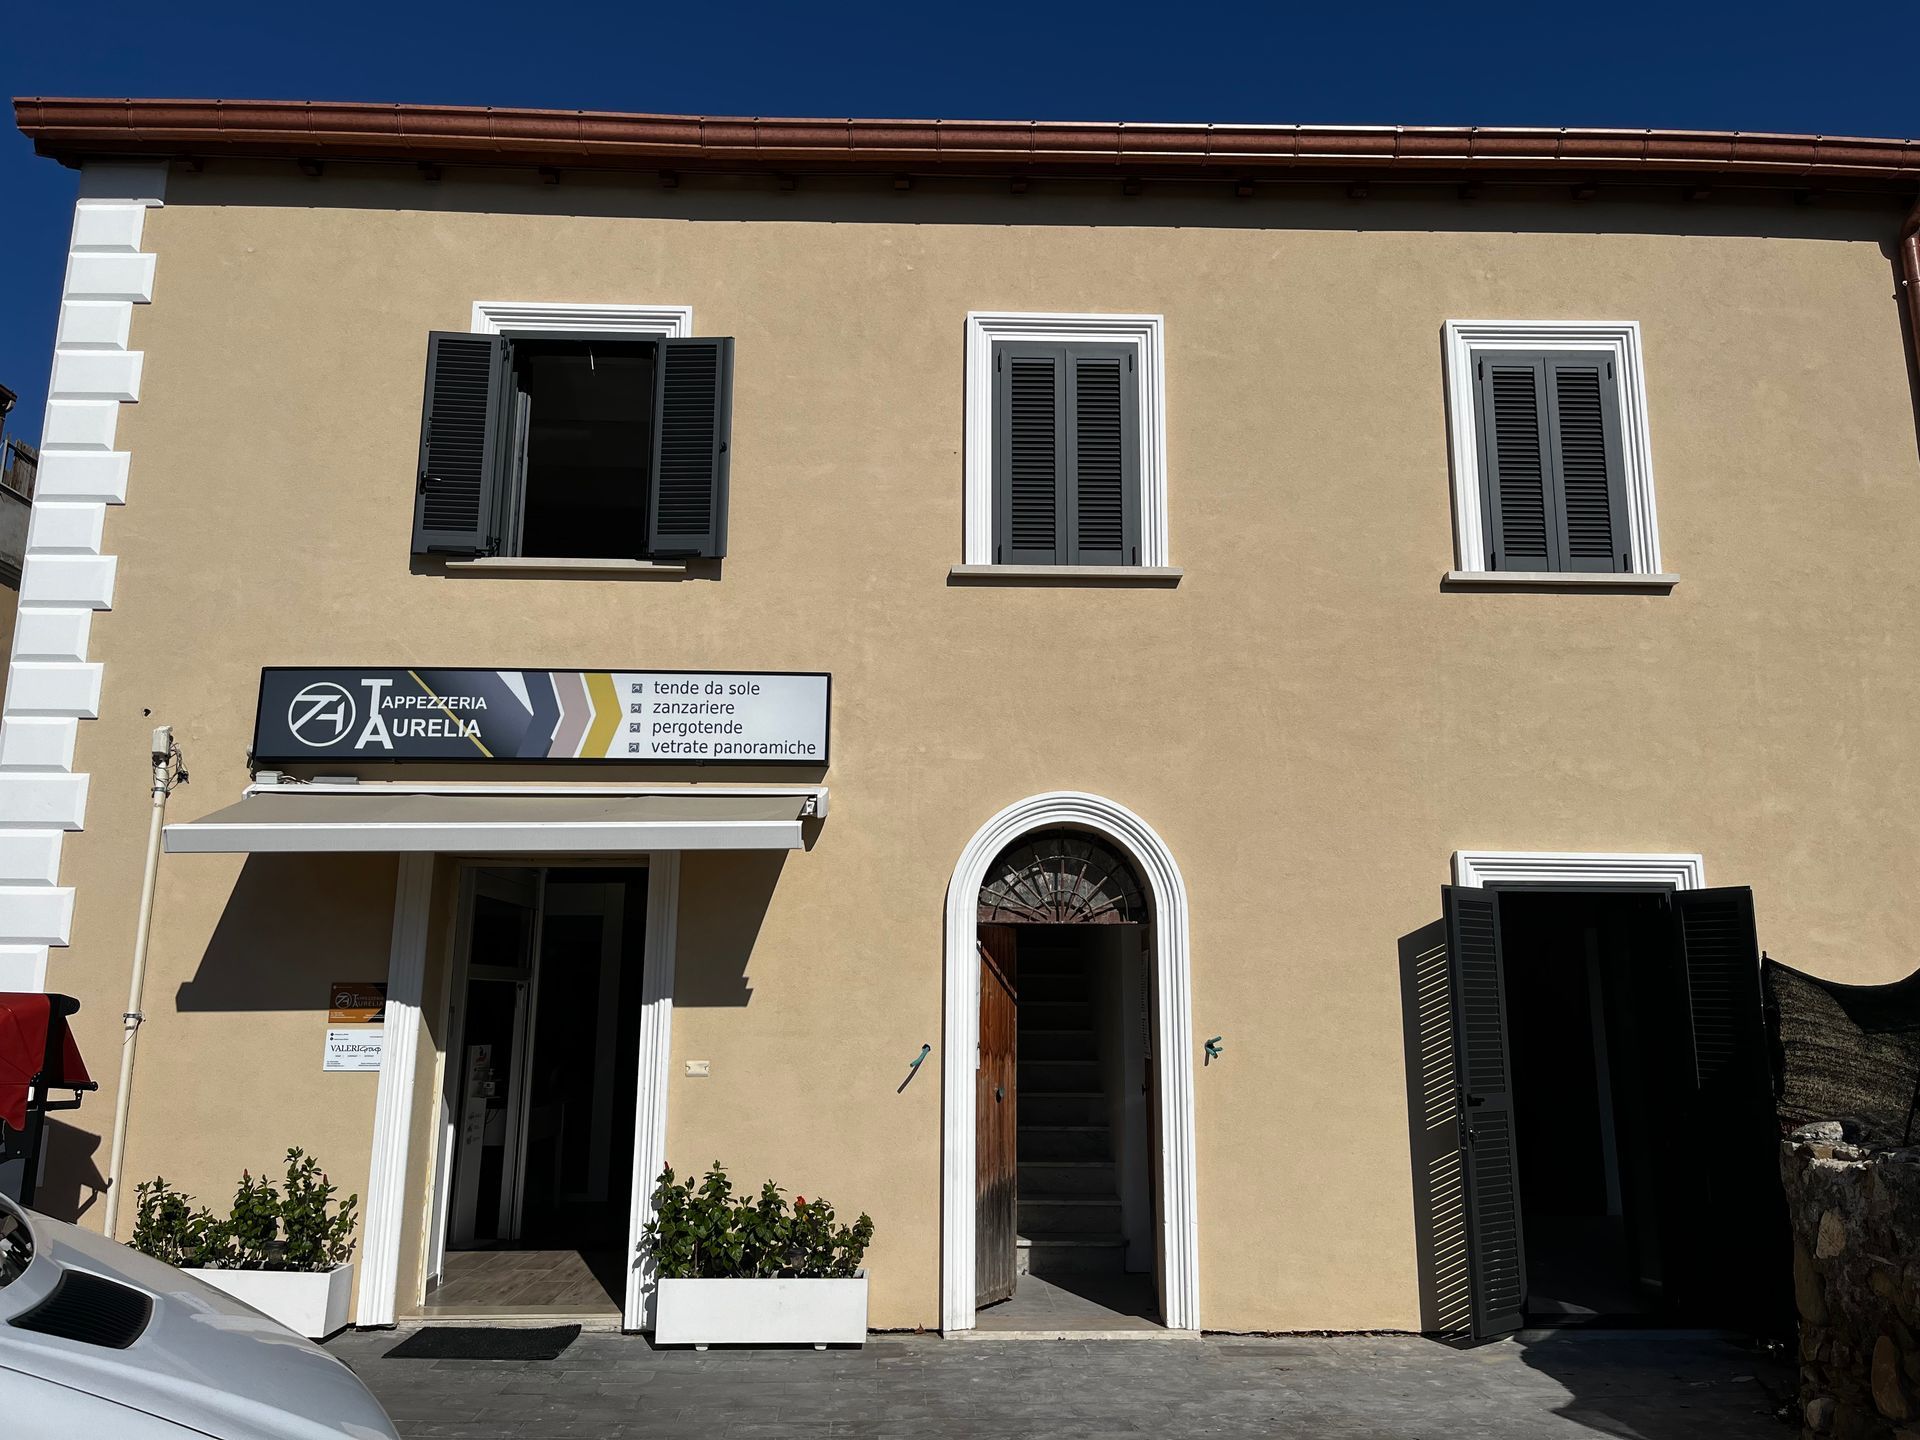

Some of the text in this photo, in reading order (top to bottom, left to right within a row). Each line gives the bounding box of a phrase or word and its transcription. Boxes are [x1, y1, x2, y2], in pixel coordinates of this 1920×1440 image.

[654, 681, 760, 696] tende da sole
[361, 679, 487, 717] TAPPEZZERIA
[653, 700, 735, 714] zanzariere
[354, 714, 482, 749] AURELIA
[652, 720, 743, 736] pergotende
[651, 740, 816, 756] vetrate panoramiche
